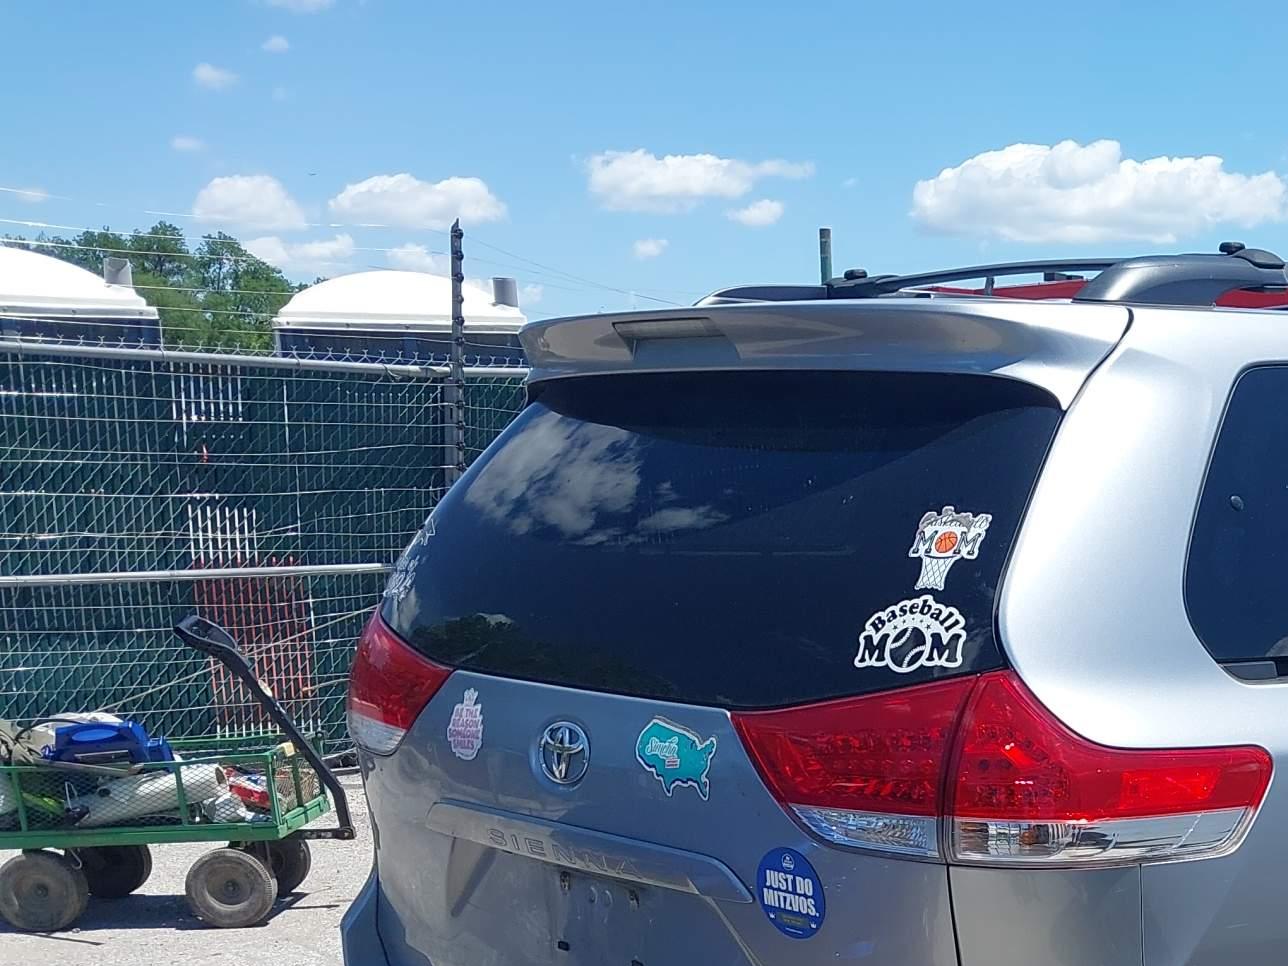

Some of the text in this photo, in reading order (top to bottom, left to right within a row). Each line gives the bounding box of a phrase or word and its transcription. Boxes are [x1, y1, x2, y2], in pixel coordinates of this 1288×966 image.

[869, 598, 961, 634] Baseball
[487, 828, 644, 880] SIENNA
[765, 869, 814, 897] JUST DO
[762, 887, 820, 918] MITZVOS.
